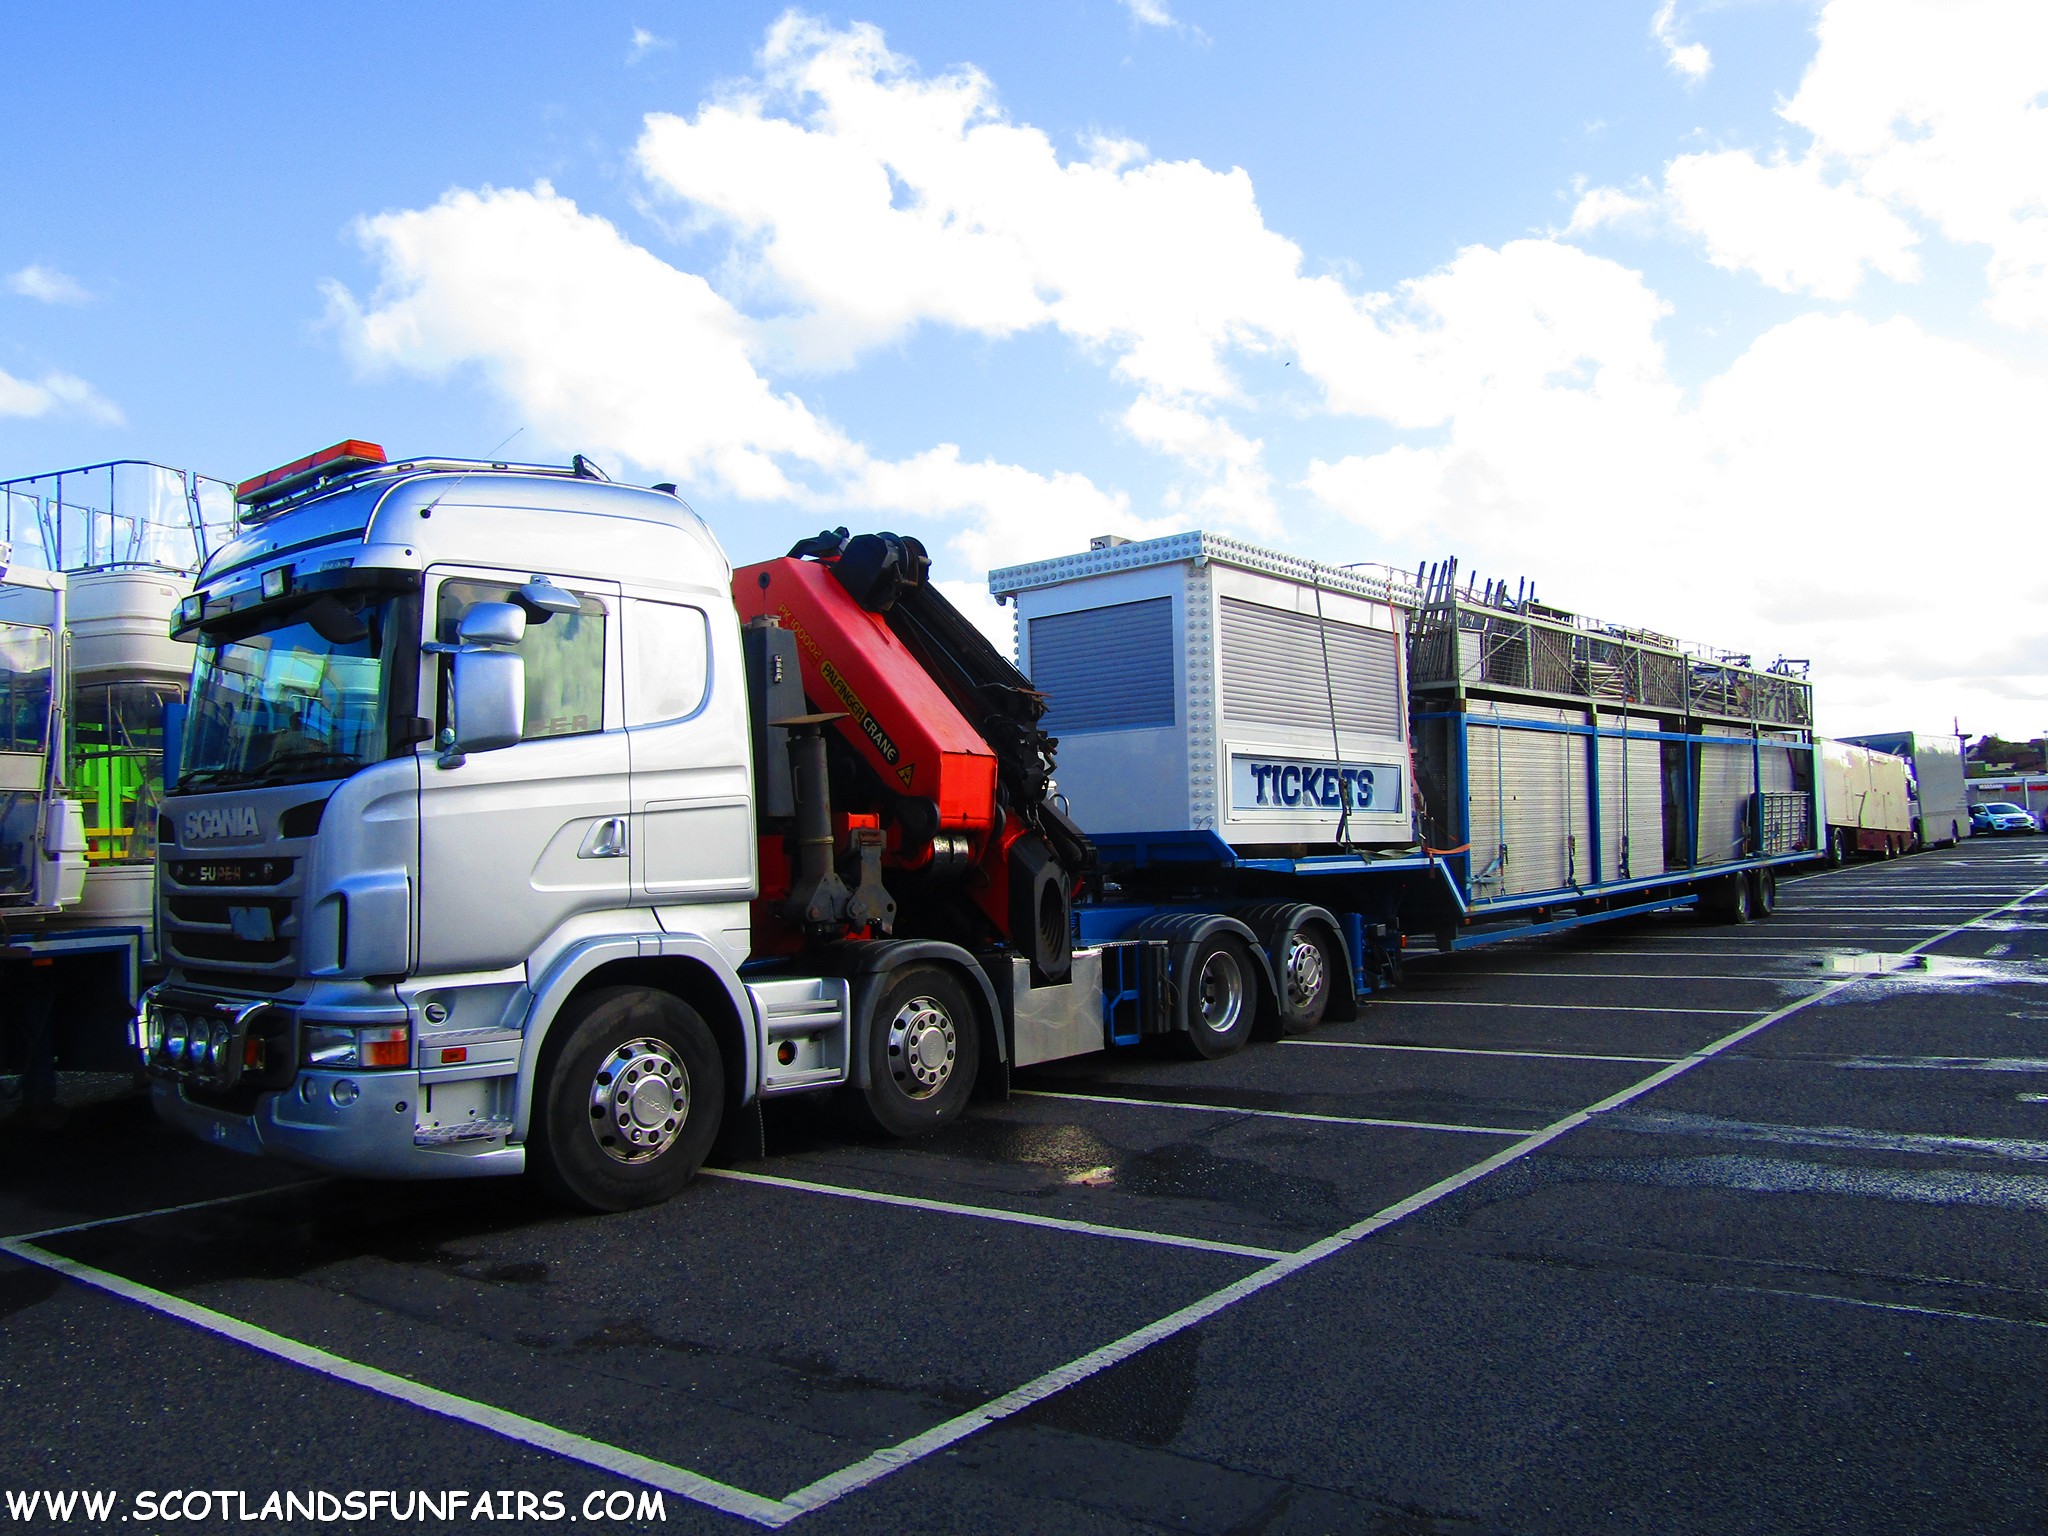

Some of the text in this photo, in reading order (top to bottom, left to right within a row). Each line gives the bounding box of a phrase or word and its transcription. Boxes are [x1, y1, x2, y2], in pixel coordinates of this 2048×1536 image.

[822, 663, 897, 761] PALFINGER CRANE
[1250, 763, 1375, 808] TICKETS
[184, 806, 260, 839] SCANIA
